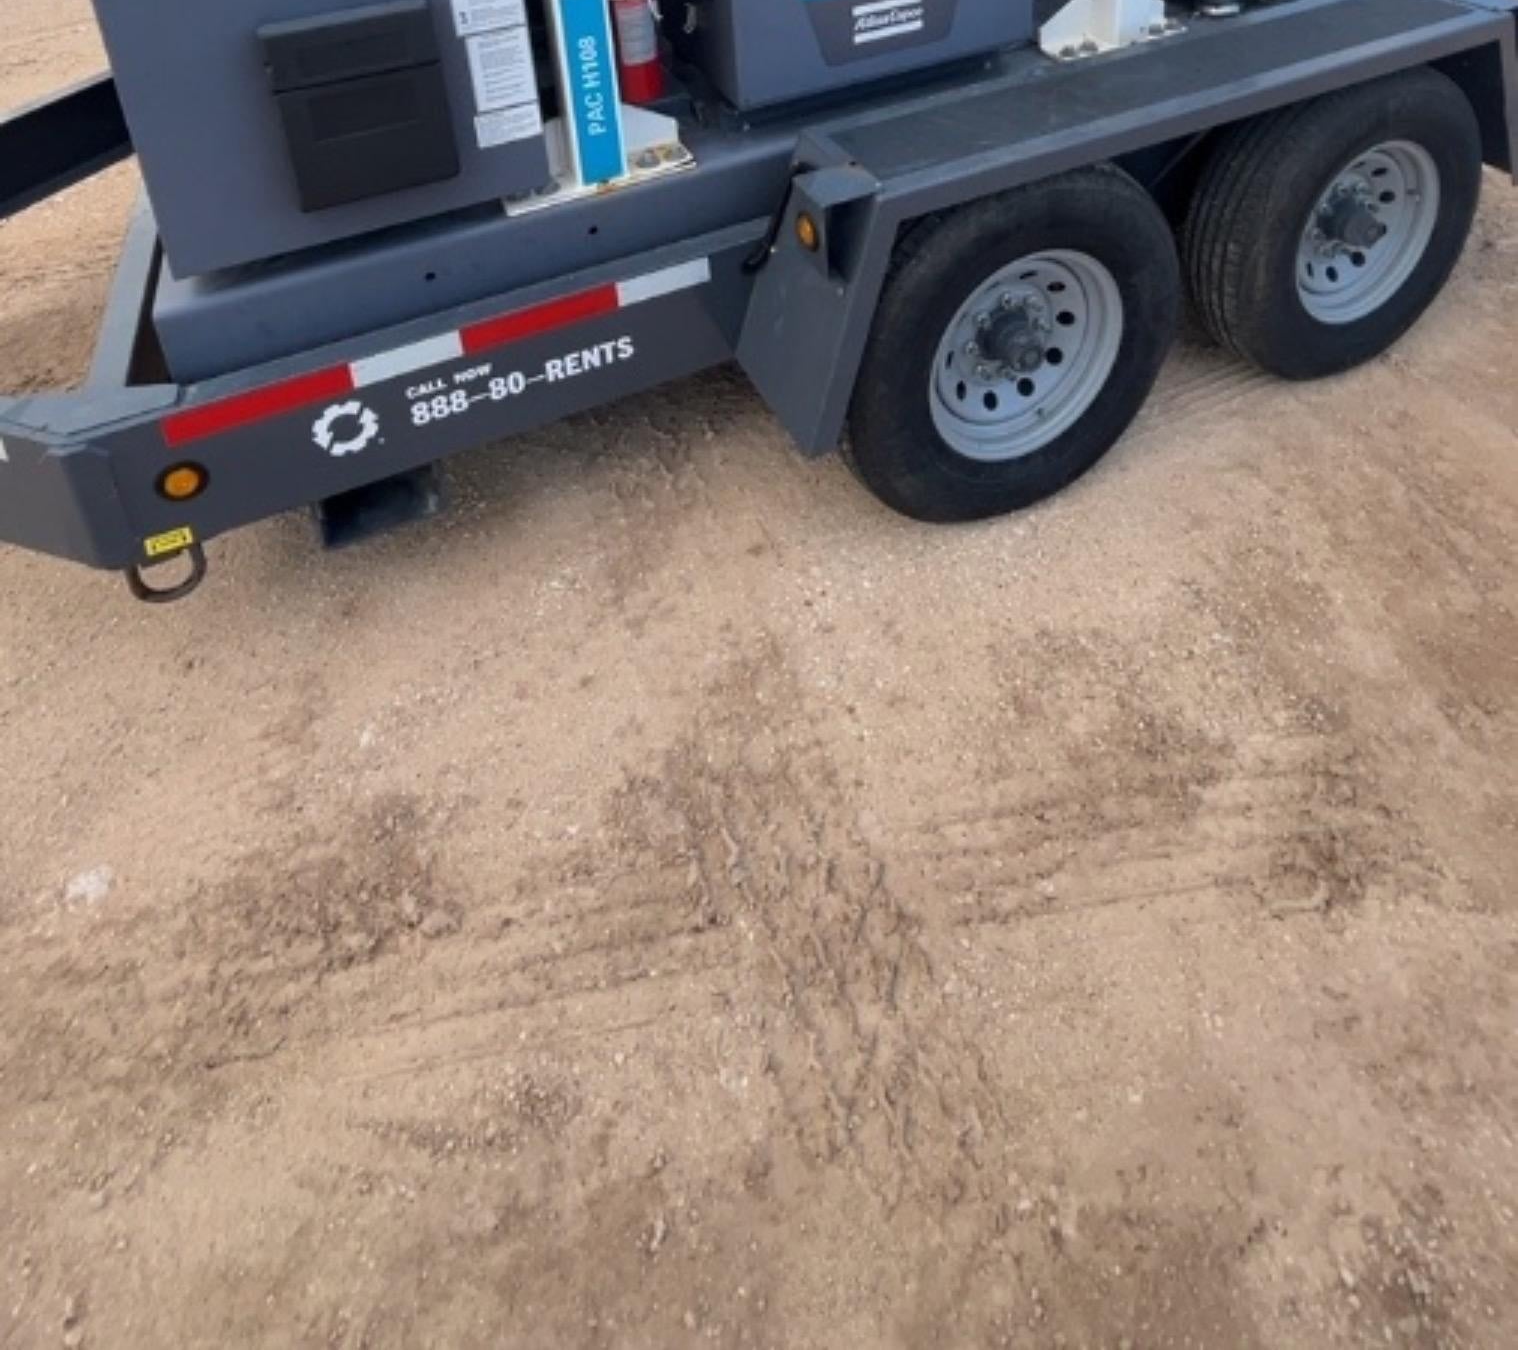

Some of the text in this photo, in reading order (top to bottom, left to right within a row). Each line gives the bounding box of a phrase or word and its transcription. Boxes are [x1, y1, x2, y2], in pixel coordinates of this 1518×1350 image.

[577, 35, 607, 137] PAC H108
[405, 362, 493, 400] CALL NOW
